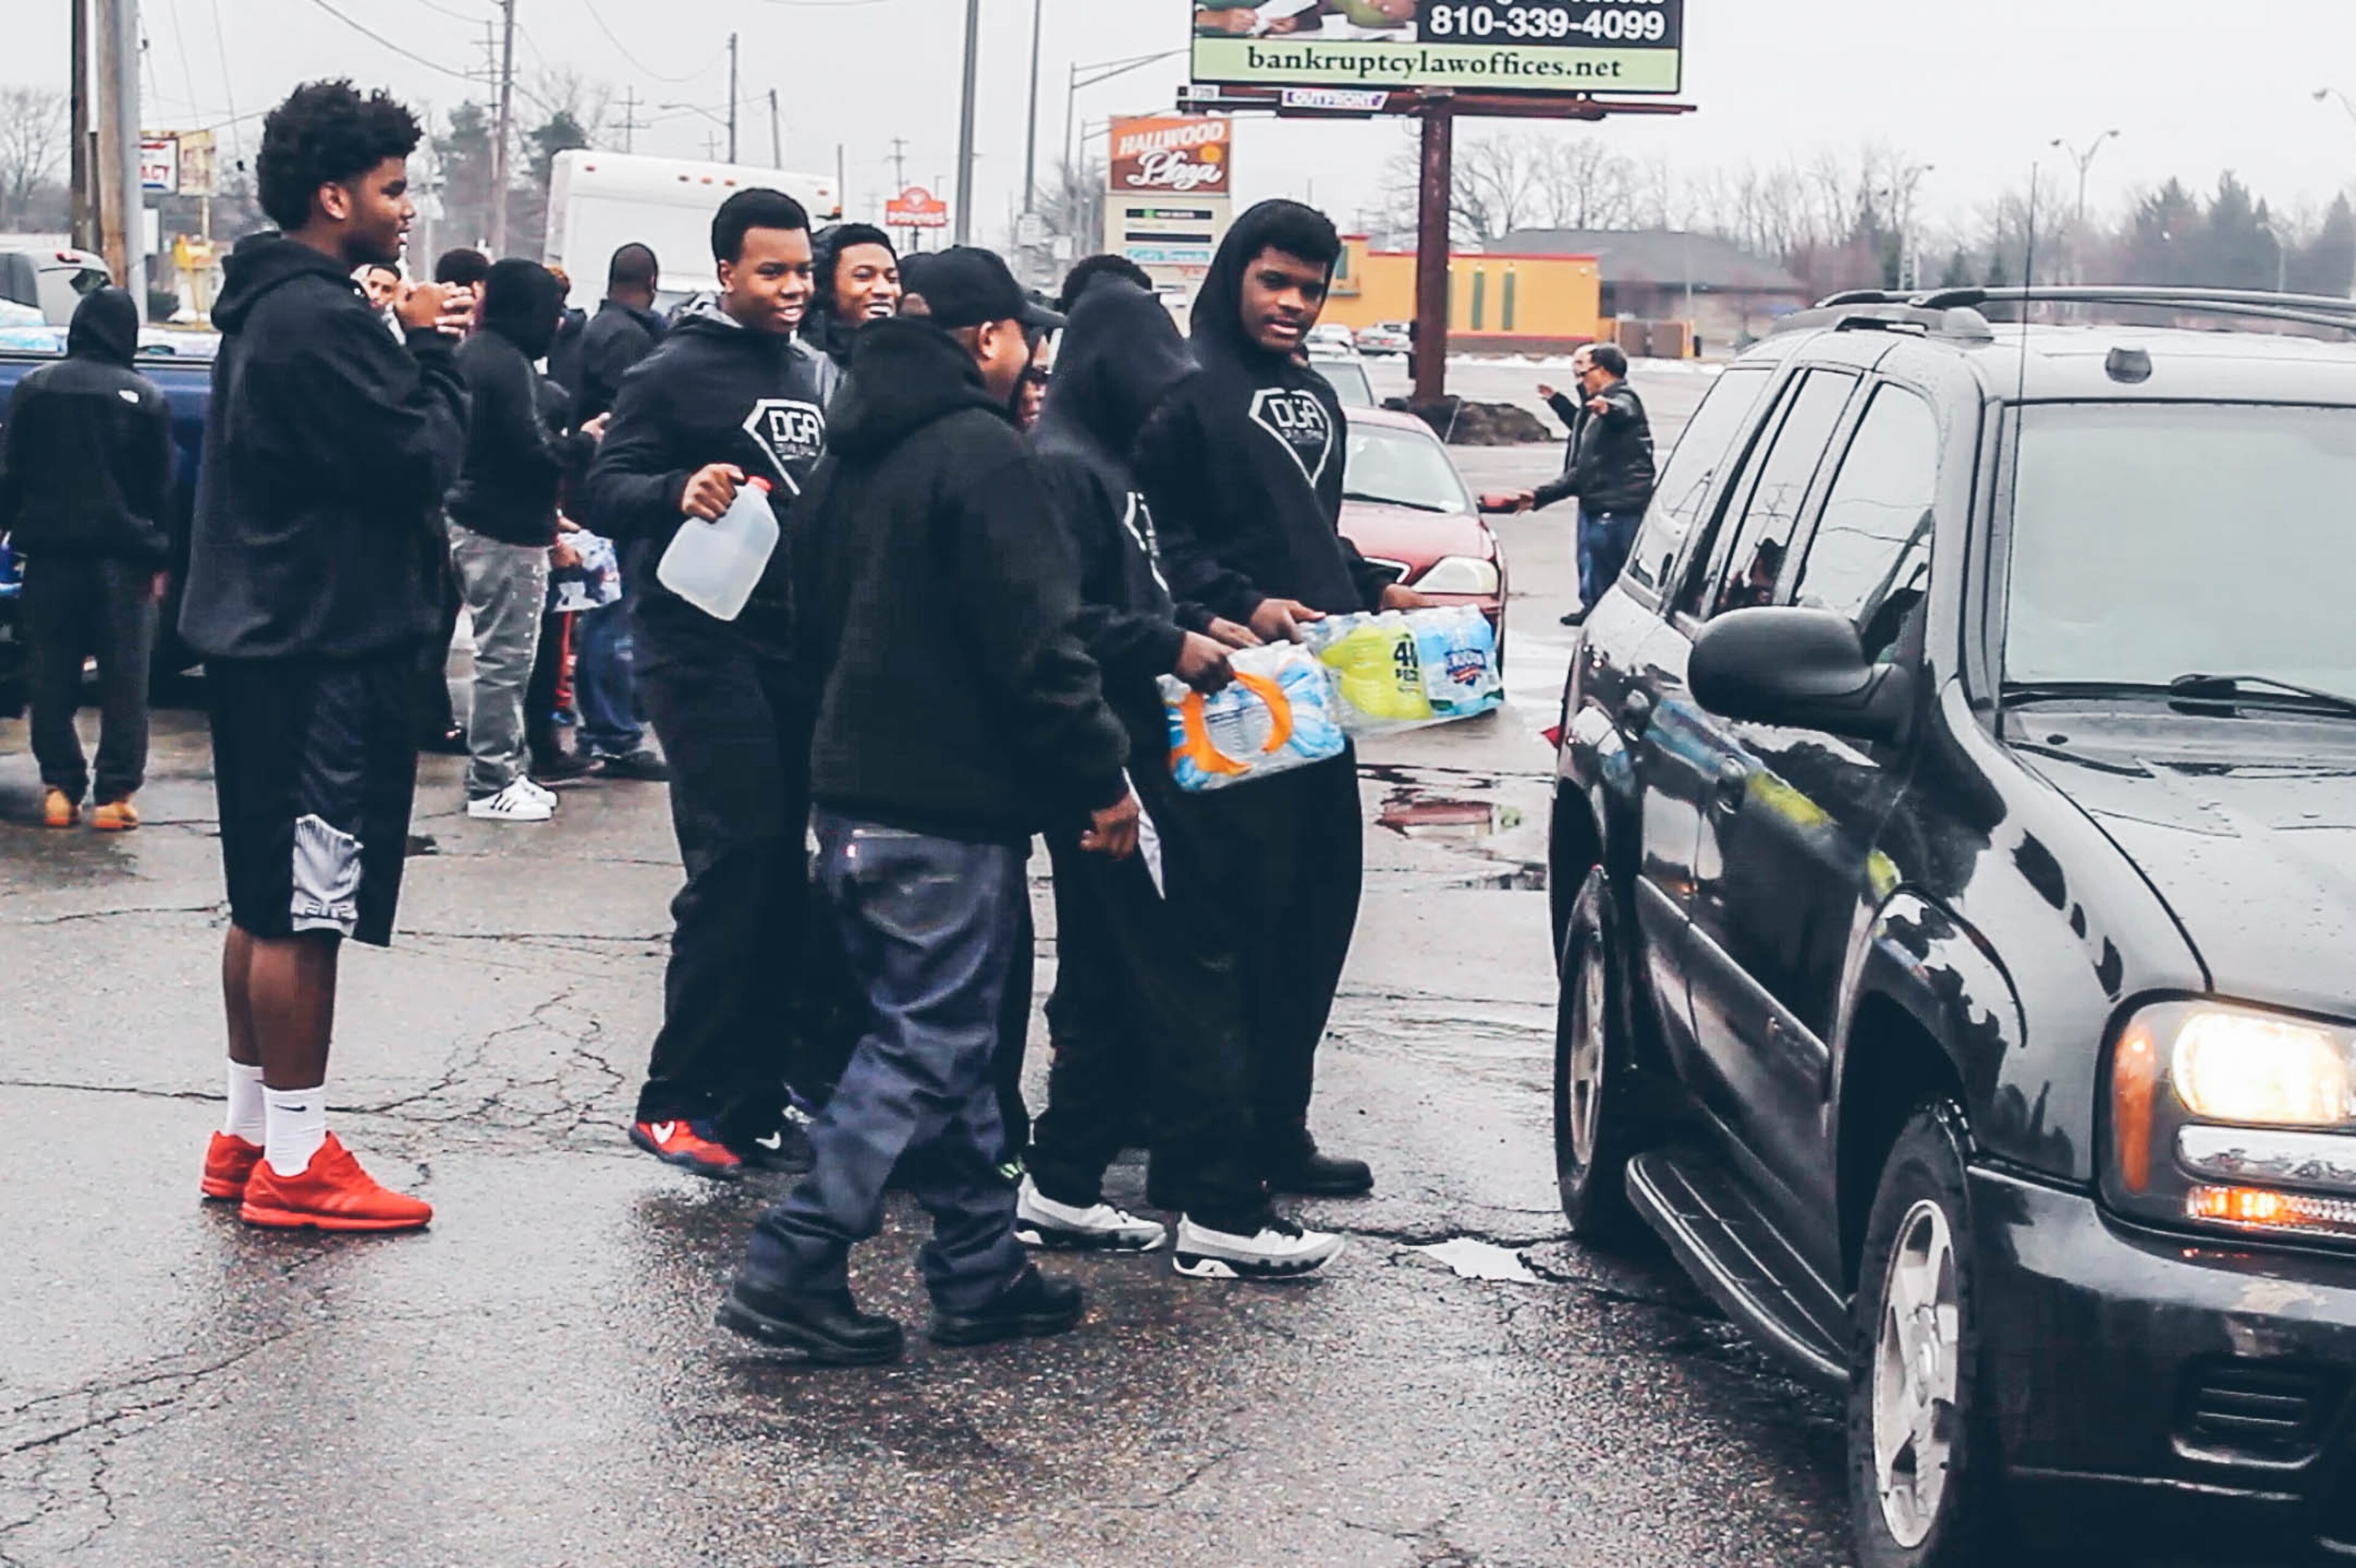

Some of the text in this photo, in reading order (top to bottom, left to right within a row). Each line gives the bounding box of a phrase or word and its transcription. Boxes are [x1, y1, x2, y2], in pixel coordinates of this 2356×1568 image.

[1430, 5, 1665, 39] 810-339-4099
[1248, 45, 1621, 79] bankruptcylawoffices.net
[1118, 122, 1225, 155] HALLWOOD
[768, 410, 820, 446] DGA
